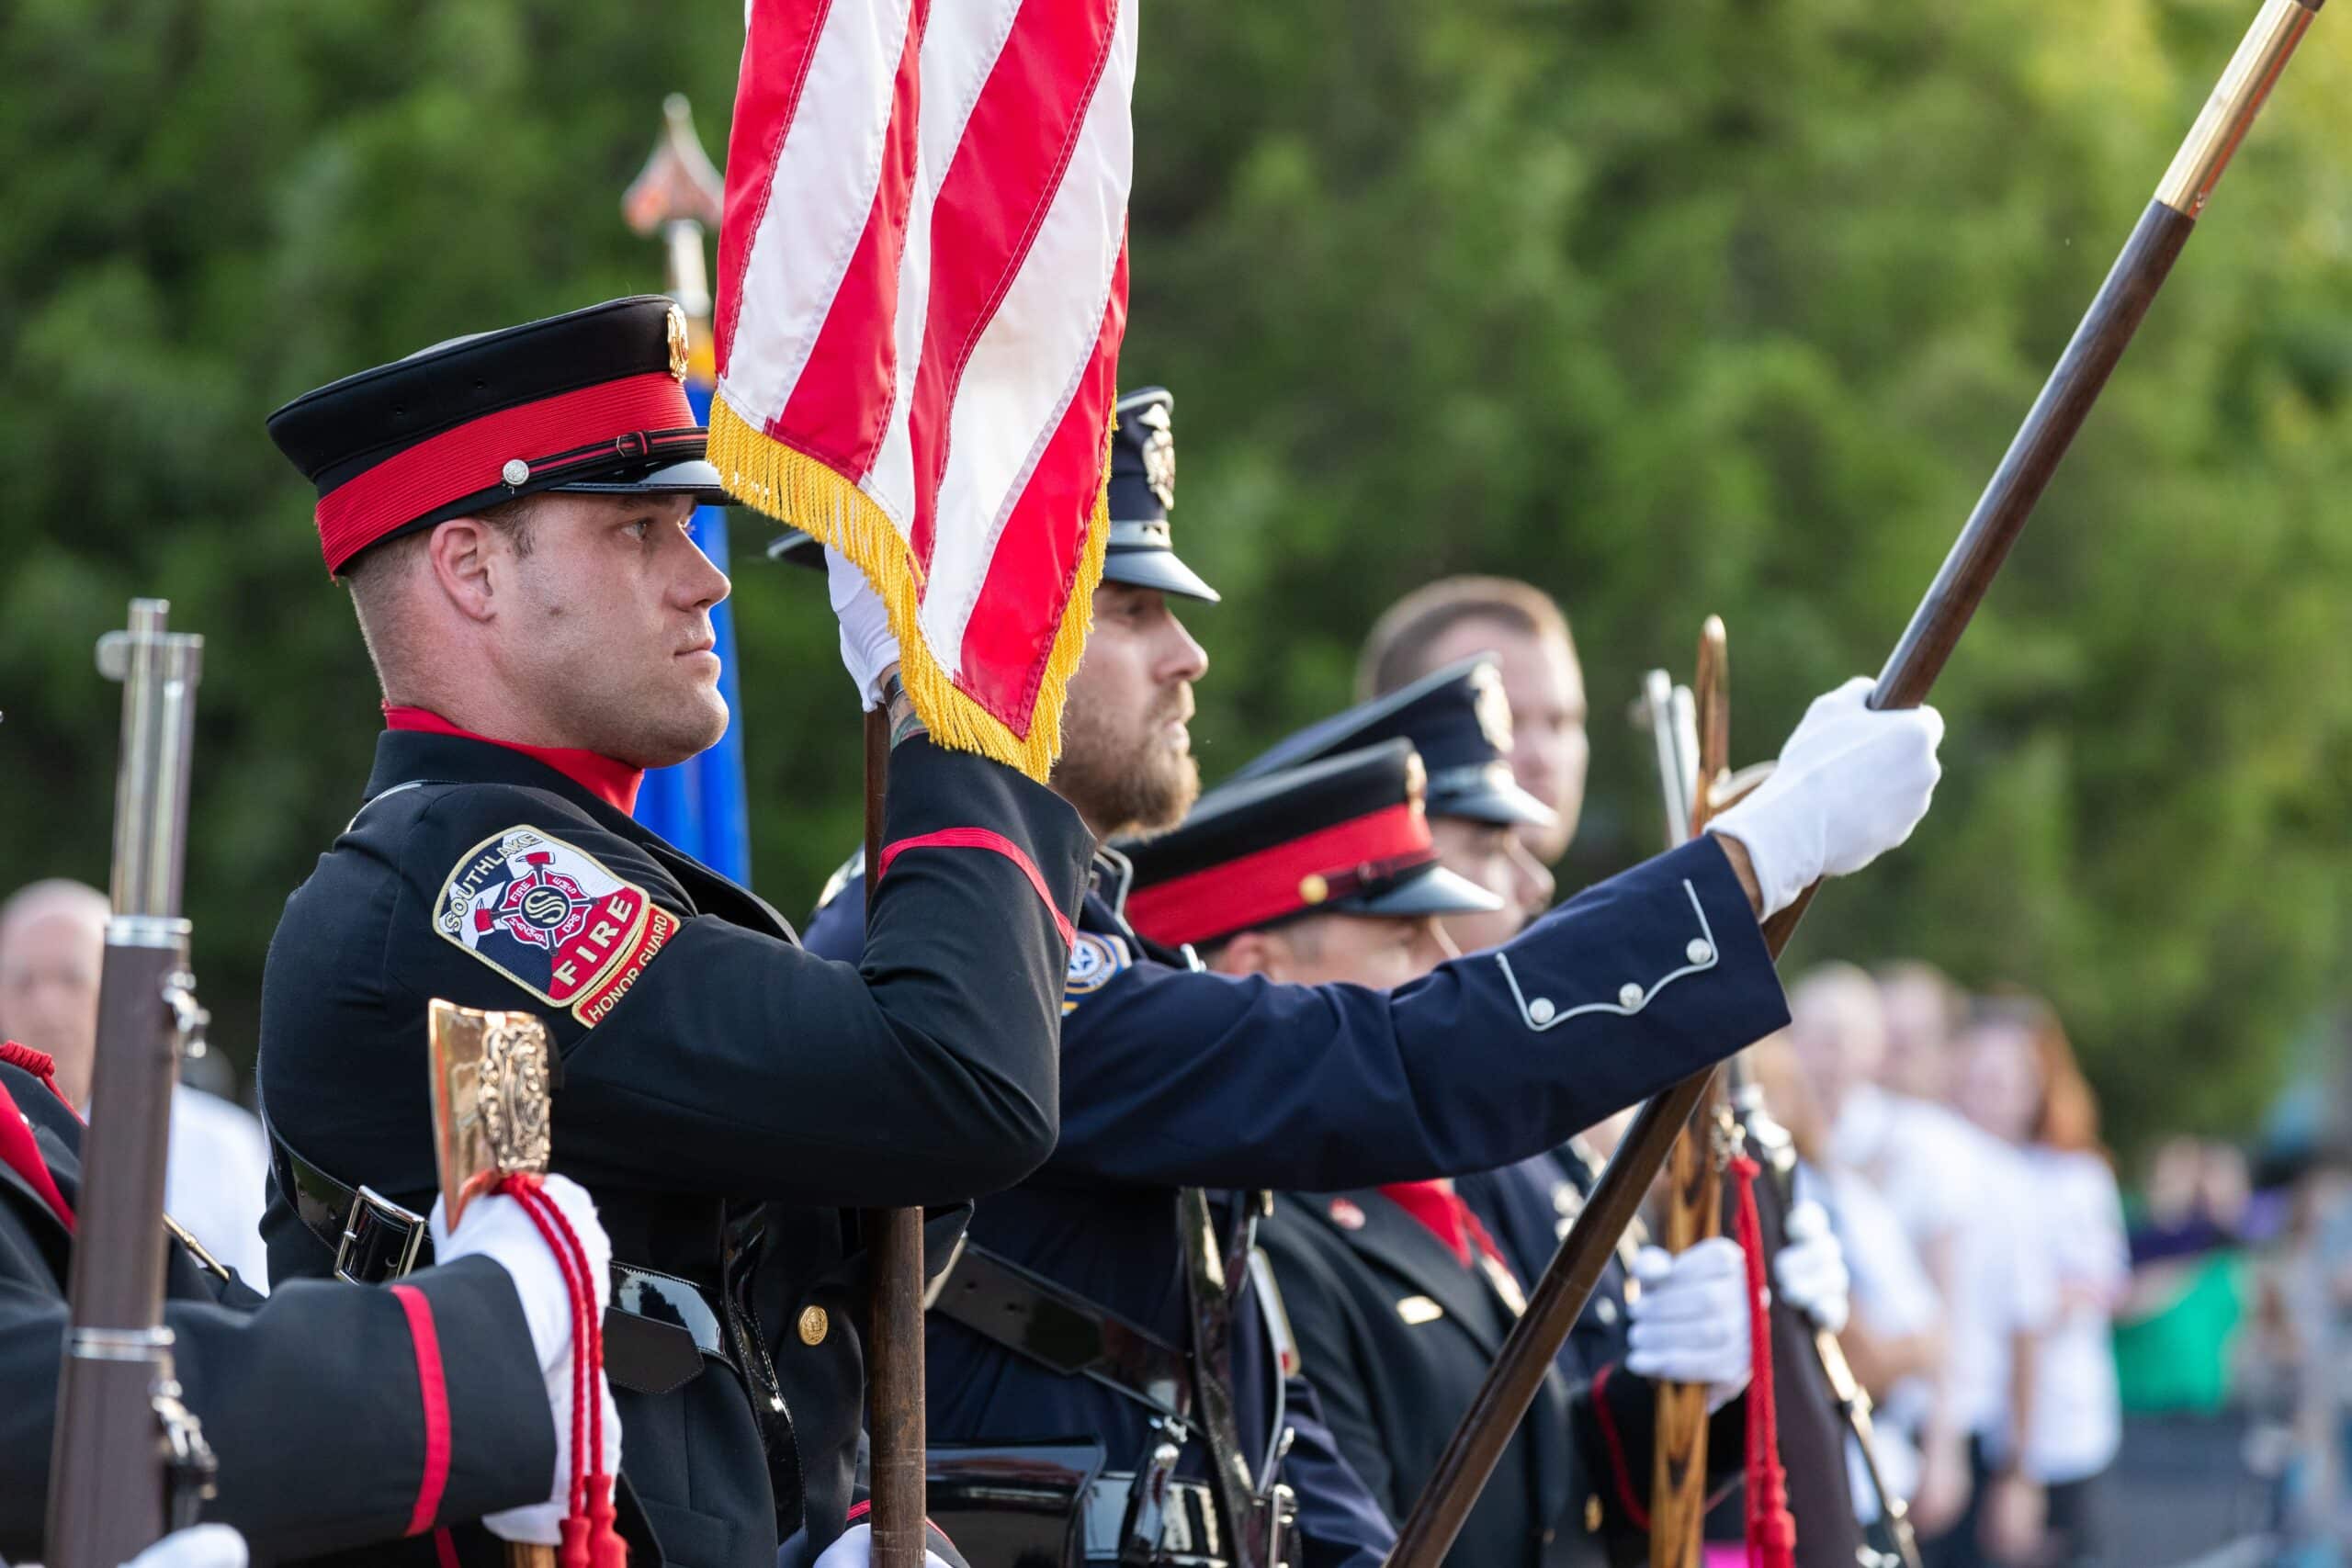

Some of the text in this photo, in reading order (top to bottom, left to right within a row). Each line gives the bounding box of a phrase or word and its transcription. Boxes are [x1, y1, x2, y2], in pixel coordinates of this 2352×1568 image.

[446, 833, 544, 932] SOUTHLAKE
[510, 881, 531, 902] FIRE
[552, 876, 577, 895] EMS
[552, 896, 633, 987] FIRE
[562, 913, 581, 933] DPS
[587, 916, 668, 1022] HONOR GUARD
